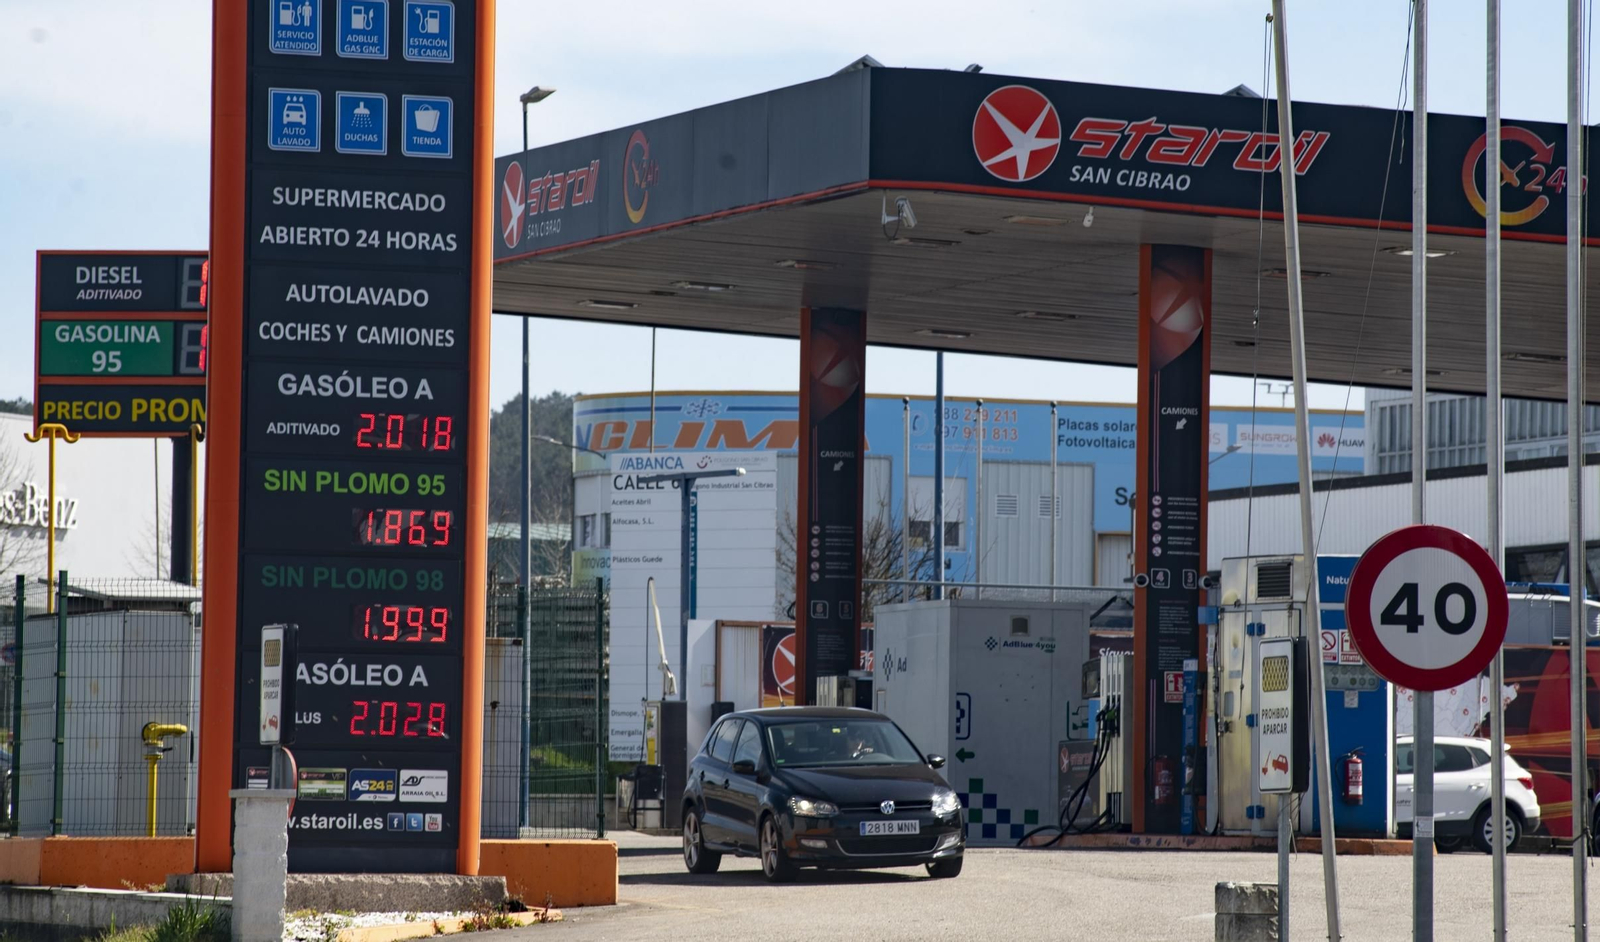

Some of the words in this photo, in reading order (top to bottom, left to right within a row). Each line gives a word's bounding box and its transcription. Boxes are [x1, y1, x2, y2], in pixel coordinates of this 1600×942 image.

[277, 30, 314, 40] SERVICIO
[346, 34, 379, 44] ADBLUE
[409, 37, 448, 47] ESTACIÓN
[275, 41, 317, 51] ATENDIDO
[344, 44, 361, 53] GAS
[362, 45, 380, 54] GNC
[408, 47, 419, 56] DE
[420, 48, 448, 58] CARGA
[282, 127, 306, 136] AUTO
[344, 133, 378, 143] DUCHAS
[277, 137, 311, 147] LAVADO
[412, 136, 442, 146] TIENDA
[1069, 164, 1111, 184] SAN
[1116, 170, 1191, 191] CIBRAO
[1524, 164, 1588, 195] 24
[527, 159, 600, 216] staroil
[272, 186, 446, 213] SUPERMERCADO
[527, 222, 539, 239] SAN
[540, 218, 562, 237] CIBRAO
[259, 225, 350, 247] ABIERTO
[356, 229, 380, 248] 24
[386, 231, 458, 252] HORAS
[76, 266, 143, 284] DIESEL
[76, 289, 142, 300] ADITIVADO
[286, 284, 429, 307] AUTOLAVADO
[55, 325, 161, 343] GASOLINA
[259, 321, 331, 342] COCHES
[336, 324, 348, 343] Y
[356, 325, 455, 347] CAMIONES
[91, 350, 122, 373] 95
[278, 370, 409, 399] GASÓLEO
[414, 378, 434, 400] A
[43, 401, 121, 420] PRECIO
[1161, 407, 1198, 415] CAMIONES
[266, 422, 341, 436] ADITIVADO
[357, 413, 452, 450] 2.018
[1058, 418, 1099, 431] Placas
[1103, 420, 1137, 432] solar
[264, 469, 307, 492] SIN
[316, 471, 410, 495] PLOMO
[417, 474, 446, 496] 95
[613, 475, 665, 491] CALLE
[711, 481, 740, 489] Industrial
[754, 481, 774, 489] Cibrao
[366, 510, 451, 545] 1.869
[642, 555, 663, 563] Guede
[261, 565, 304, 588] SIN
[313, 567, 408, 591] PLOMO
[416, 570, 444, 591] 98
[1156, 571, 1164, 582] 4
[1380, 582, 1477, 635] 40
[364, 607, 448, 642] 1.999
[1003, 640, 1034, 648] AdBlue
[296, 658, 403, 687] ASÓLEO
[409, 665, 429, 687] A
[350, 701, 446, 736] 2.028
[1262, 707, 1289, 720] PROHIBIDO
[1263, 723, 1288, 735] APARCAR
[351, 780, 385, 791] AS24
[867, 823, 894, 833] 2818
[897, 822, 917, 832] MNN
